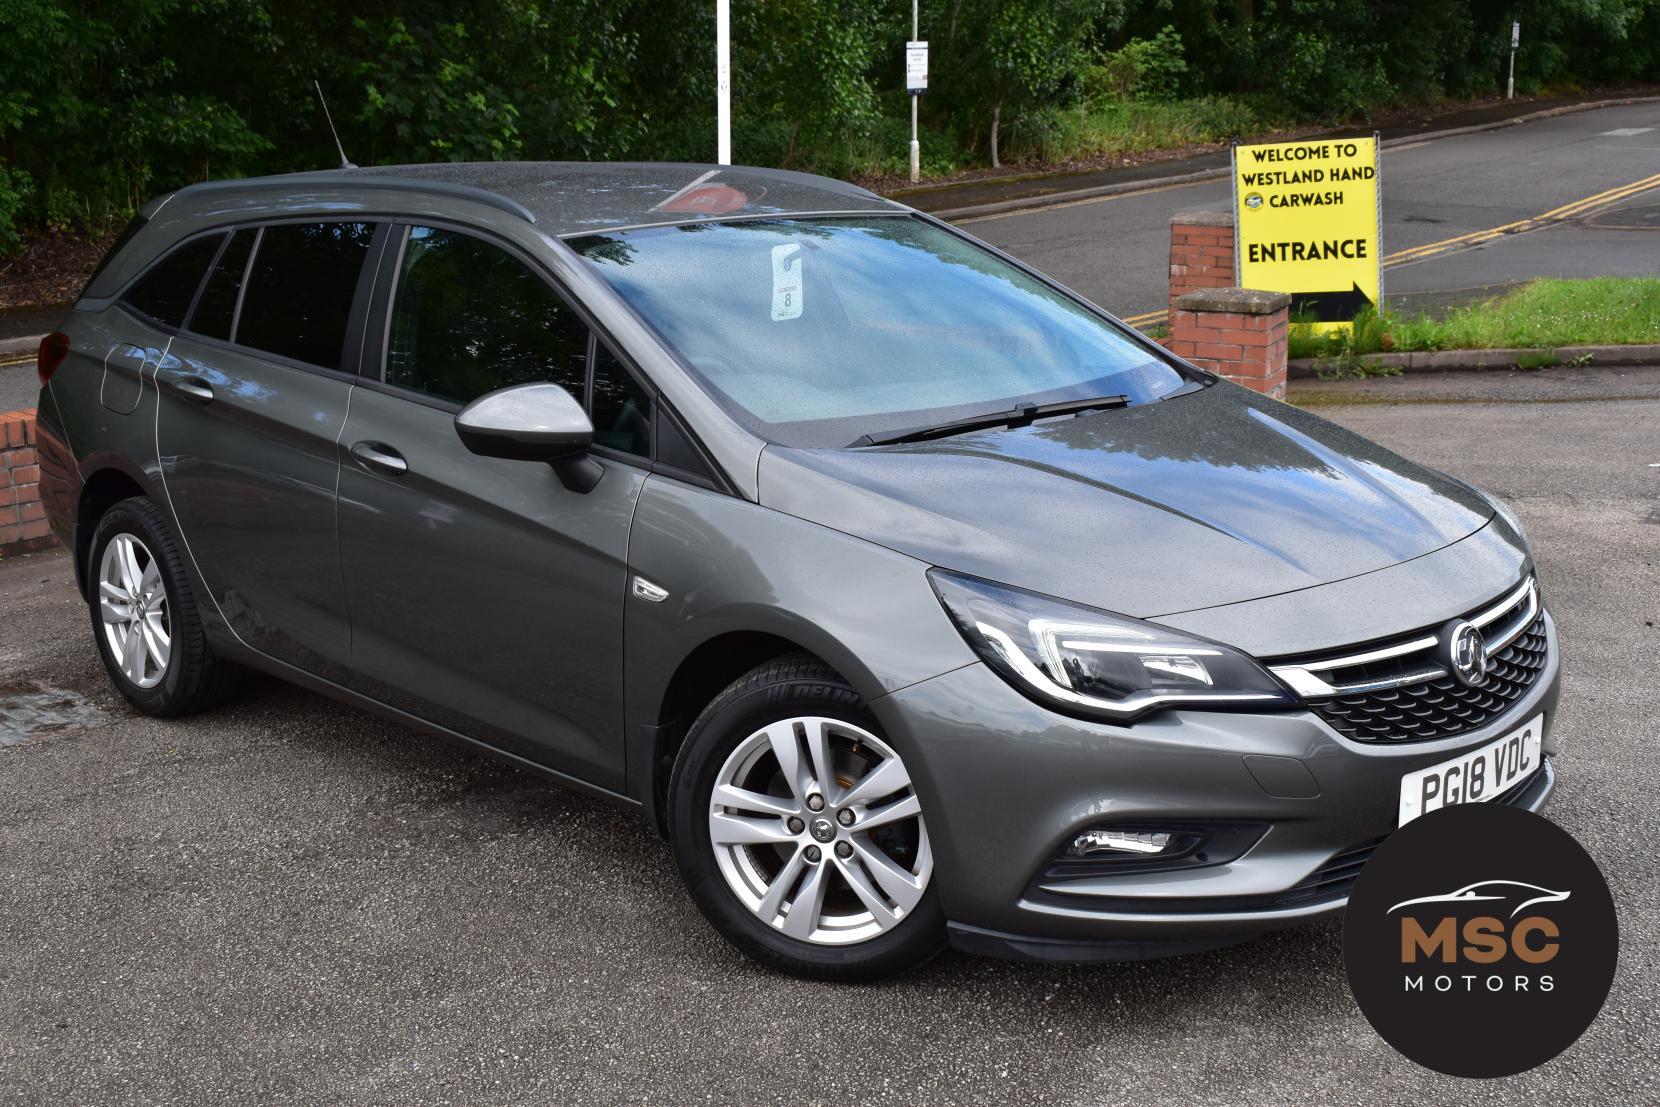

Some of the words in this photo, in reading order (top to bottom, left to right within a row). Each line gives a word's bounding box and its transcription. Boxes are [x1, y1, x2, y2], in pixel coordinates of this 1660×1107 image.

[1252, 145, 1330, 163] WELCOME
[1334, 143, 1357, 158] TO
[1241, 168, 1325, 187] WESTLAND
[1329, 166, 1375, 182] HAND
[1269, 191, 1344, 208] CARWASH
[1248, 238, 1367, 263] ENTRANCE
[785, 293, 792, 307] 8
[1420, 755, 1486, 816] PG18
[1494, 728, 1532, 788] VDC
